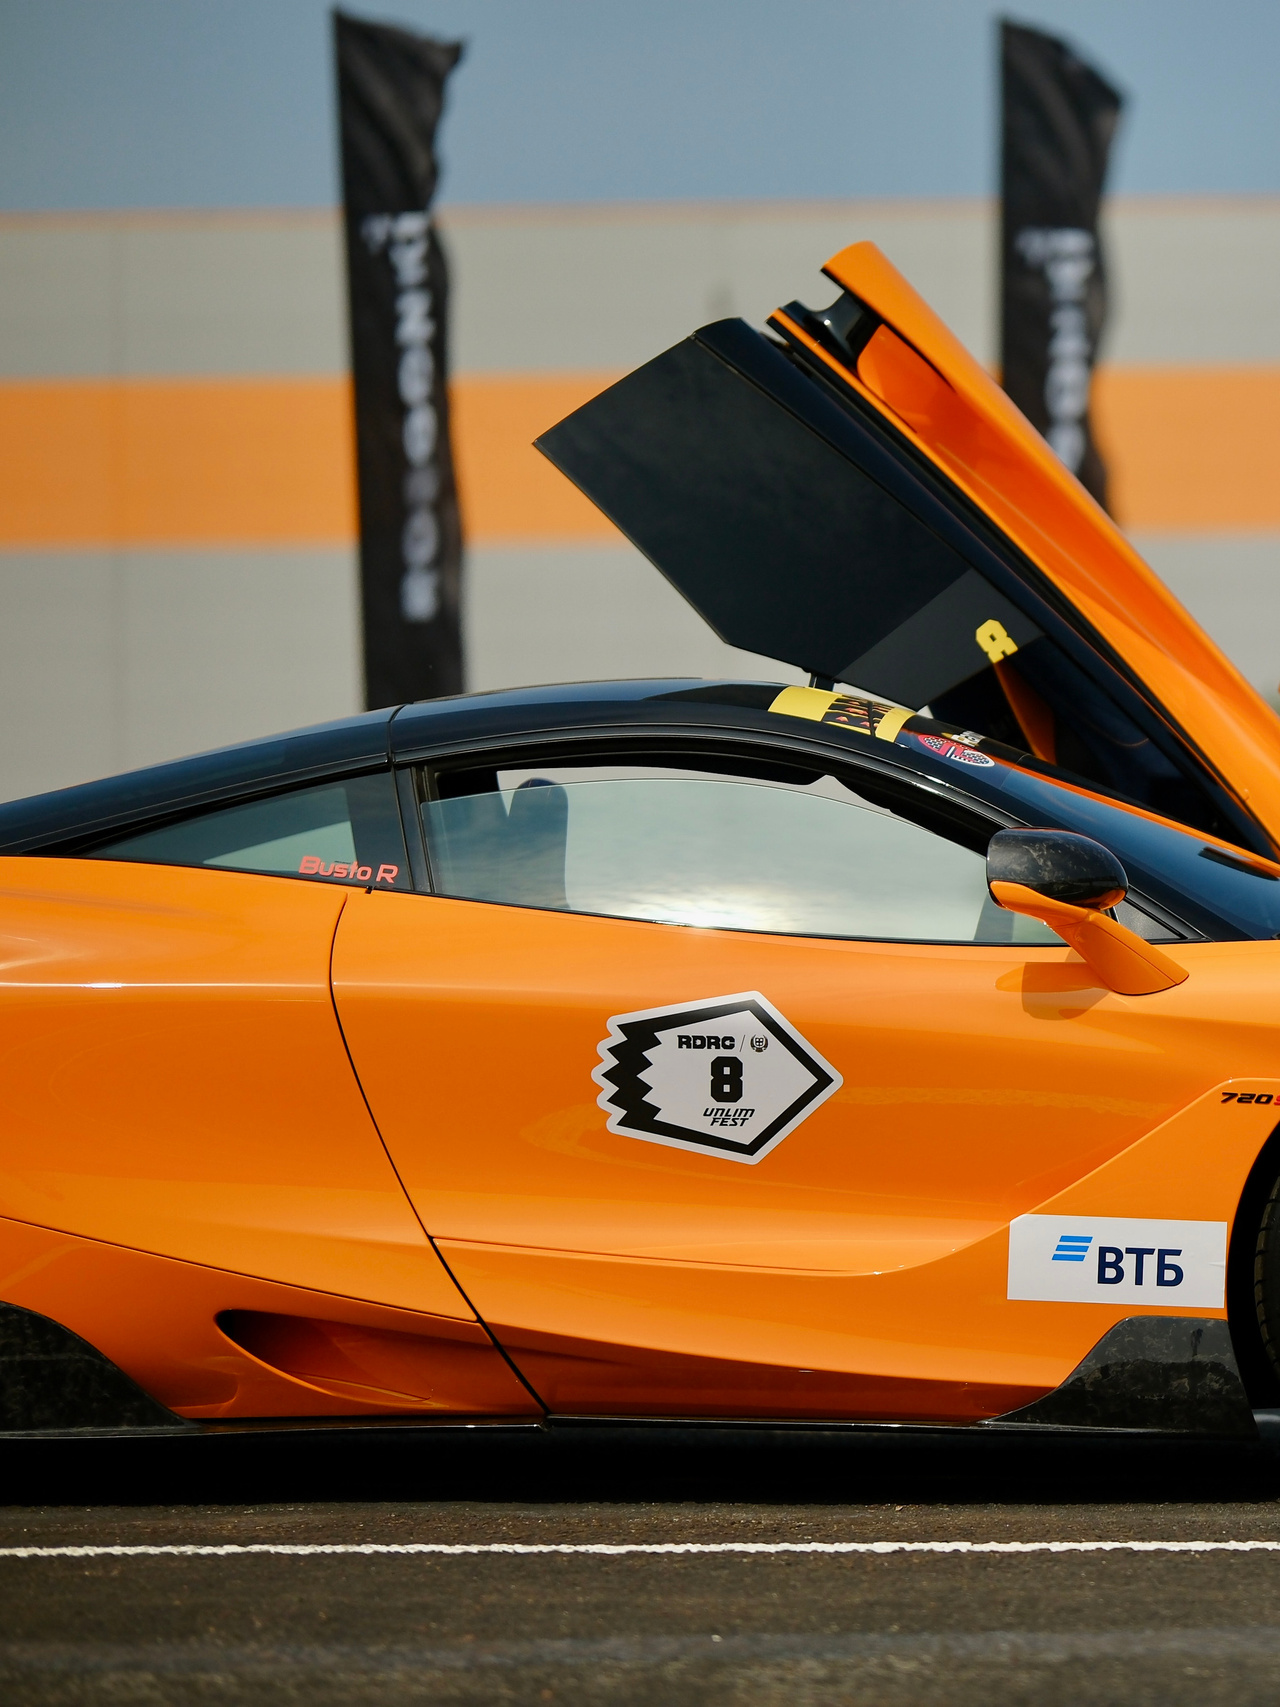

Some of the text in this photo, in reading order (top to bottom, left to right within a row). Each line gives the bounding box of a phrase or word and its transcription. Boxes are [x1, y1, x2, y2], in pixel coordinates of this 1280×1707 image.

[298, 855, 399, 884] Busto R
[677, 1034, 735, 1050] RDRC
[710, 1056, 743, 1103] 8
[703, 1107, 755, 1117] UNLIM
[710, 1117, 749, 1127] FEST
[1097, 1245, 1184, 1287] ВТБ
